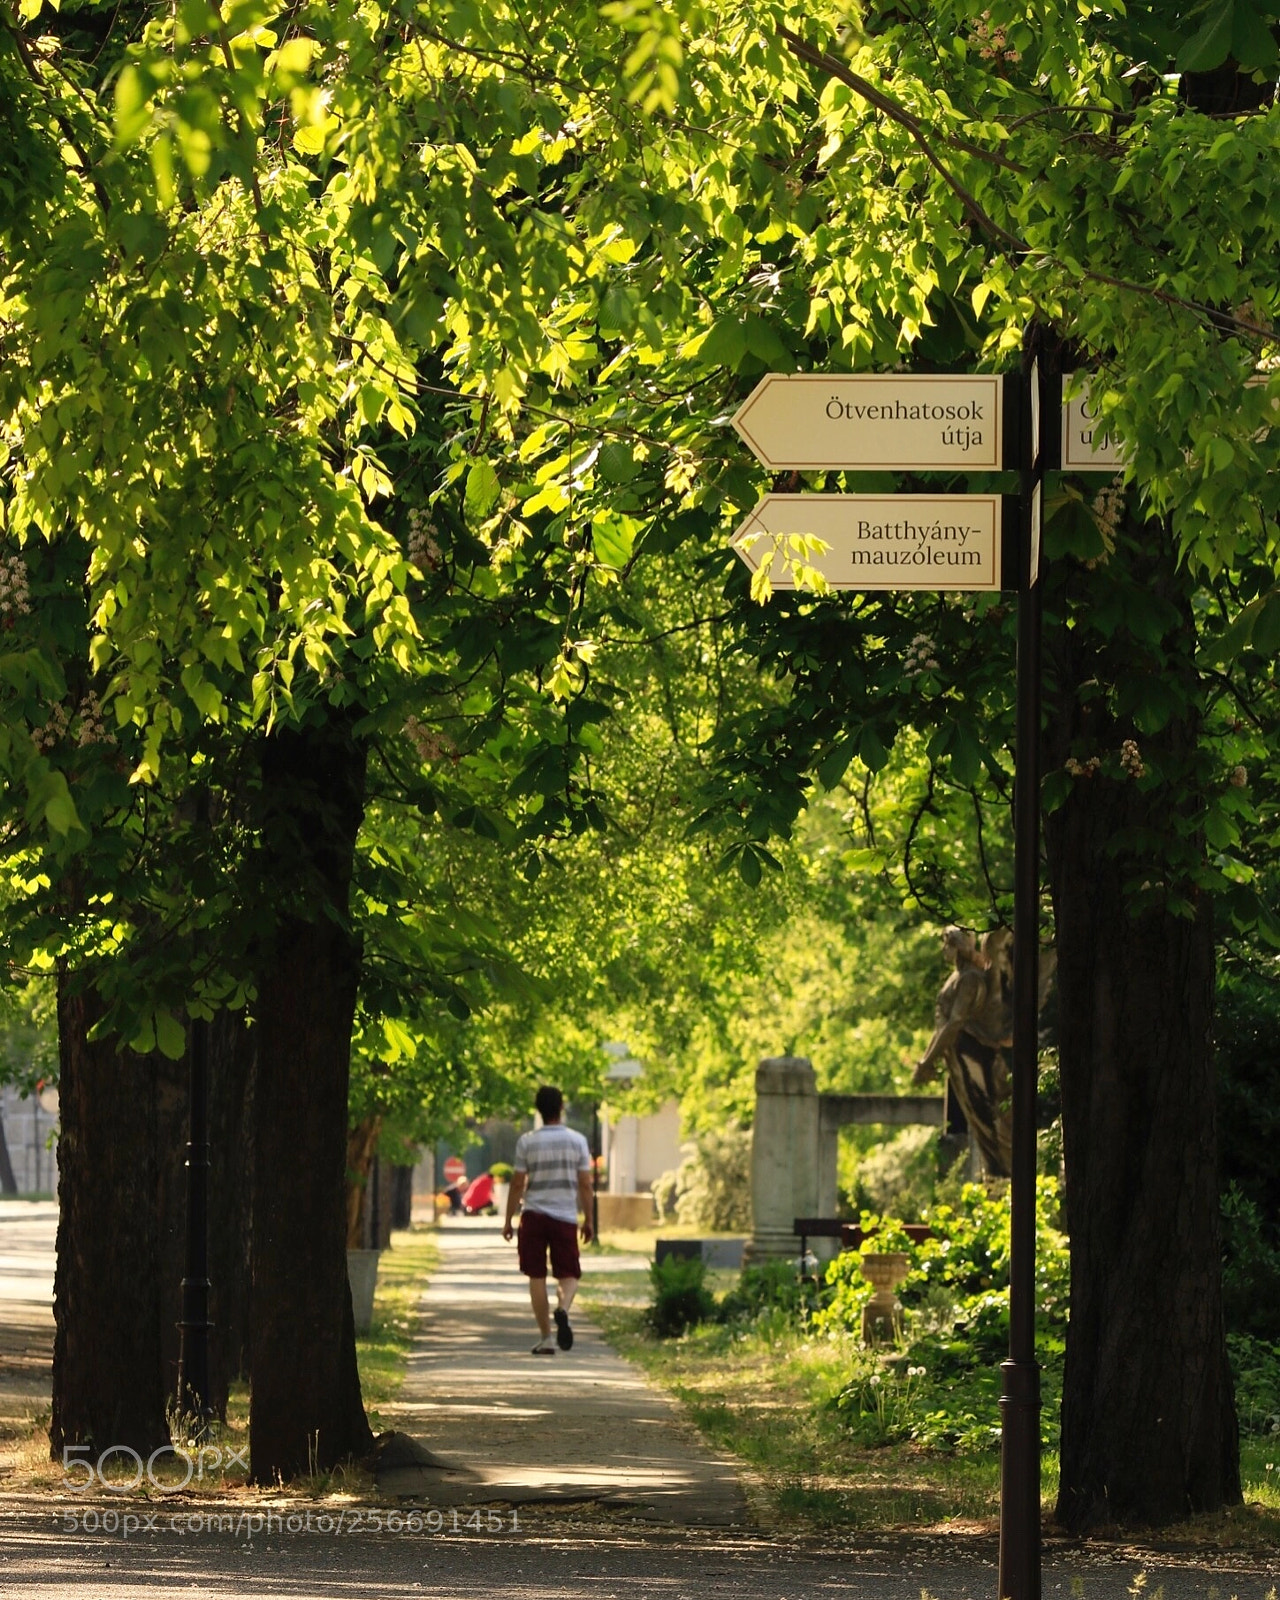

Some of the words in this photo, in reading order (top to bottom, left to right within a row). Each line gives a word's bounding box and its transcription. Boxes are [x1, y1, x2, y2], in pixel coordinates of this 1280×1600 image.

[825, 396, 984, 420] Ötvenhatosok
[941, 426, 983, 451] útja
[857, 520, 982, 546] Batthyány-
[851, 544, 982, 566] mauzóleum
